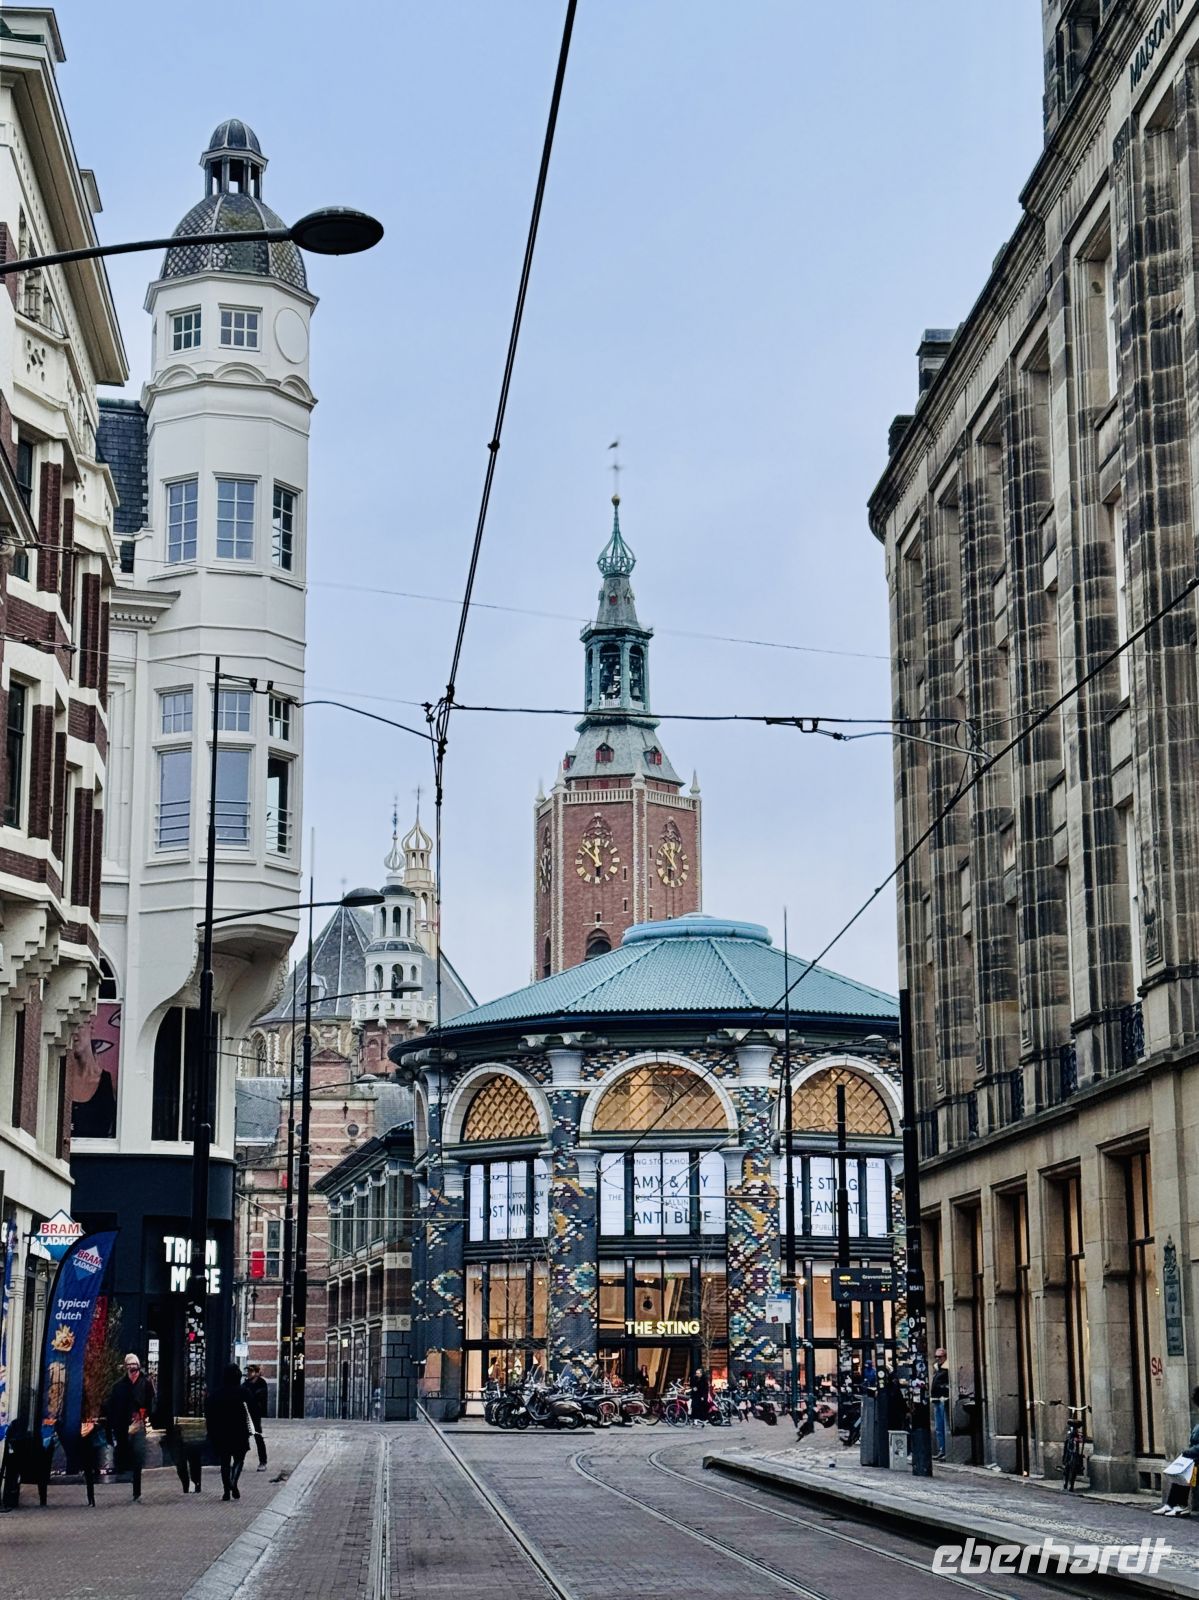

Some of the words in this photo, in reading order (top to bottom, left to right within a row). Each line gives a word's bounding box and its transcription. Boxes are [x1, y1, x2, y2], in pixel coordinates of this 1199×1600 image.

[1130, 0, 1170, 92] MAISON
[634, 1175, 661, 1188] AMY
[669, 1175, 678, 1188] &
[685, 1175, 709, 1188] IY
[818, 1177, 858, 1191] STIG
[508, 1203, 540, 1217] MINS
[634, 1211, 669, 1224] ANTI
[41, 1224, 80, 1234] BRAM
[77, 1249, 102, 1266] BRAM
[163, 1236, 217, 1265] TRN
[171, 1266, 220, 1294] ME
[57, 1298, 91, 1311] typical
[55, 1311, 82, 1320] dutch
[625, 1321, 653, 1335] THE
[656, 1320, 700, 1335] STING
